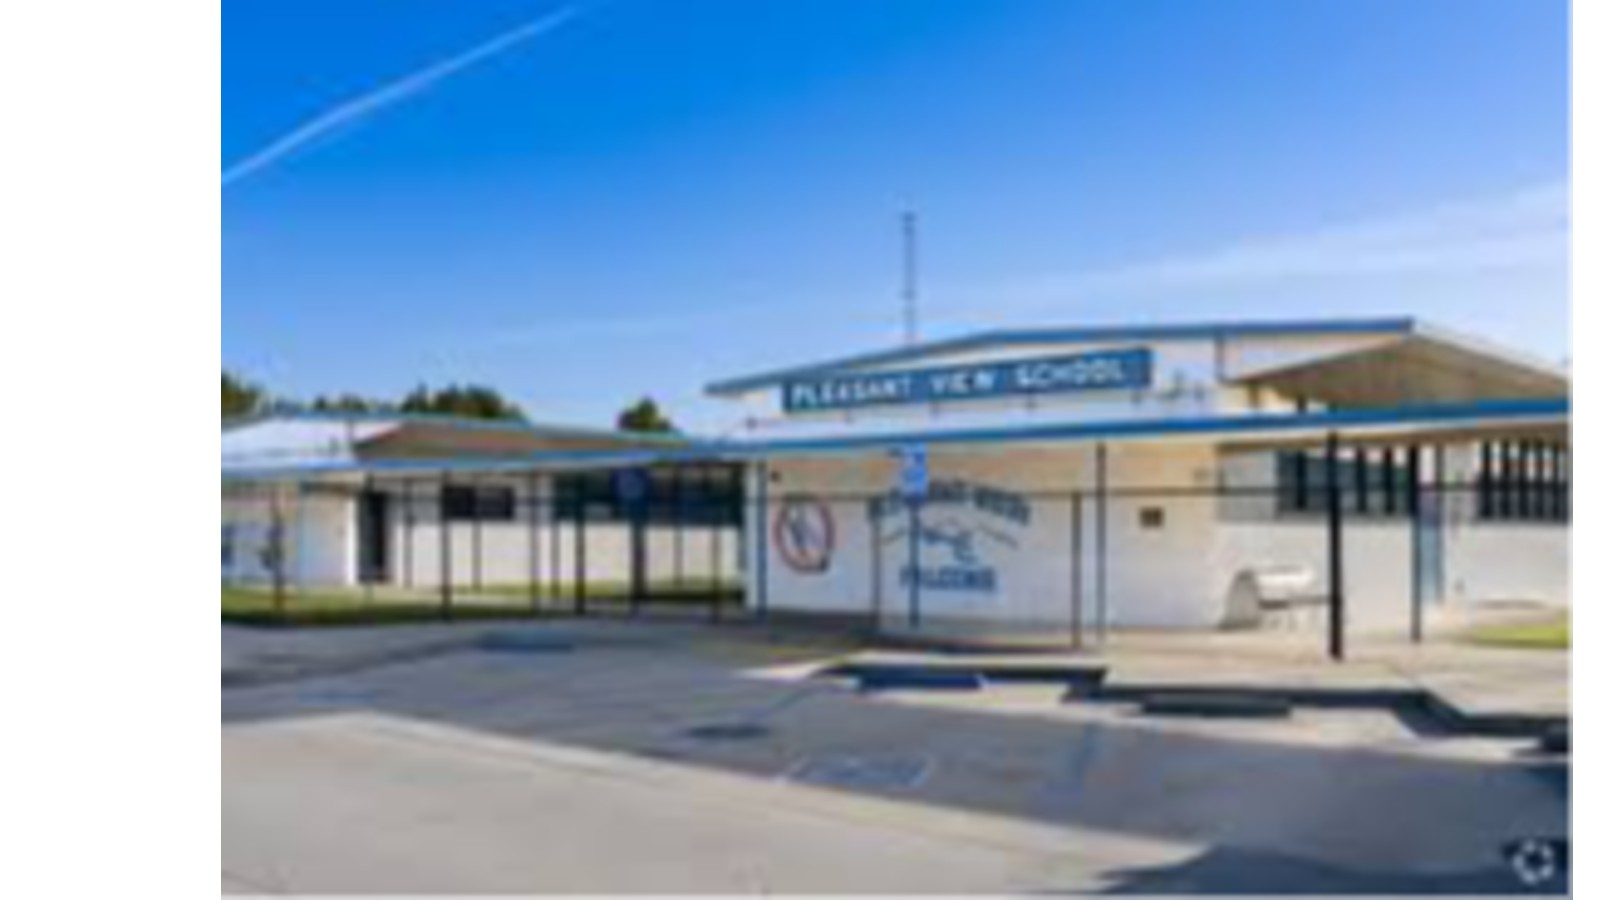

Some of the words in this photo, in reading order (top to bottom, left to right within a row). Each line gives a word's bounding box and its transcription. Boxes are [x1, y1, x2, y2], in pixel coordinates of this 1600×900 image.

[791, 377, 911, 409] PLEASANT
[931, 369, 997, 394] VIEW
[1014, 358, 1126, 389] SCHOOL
